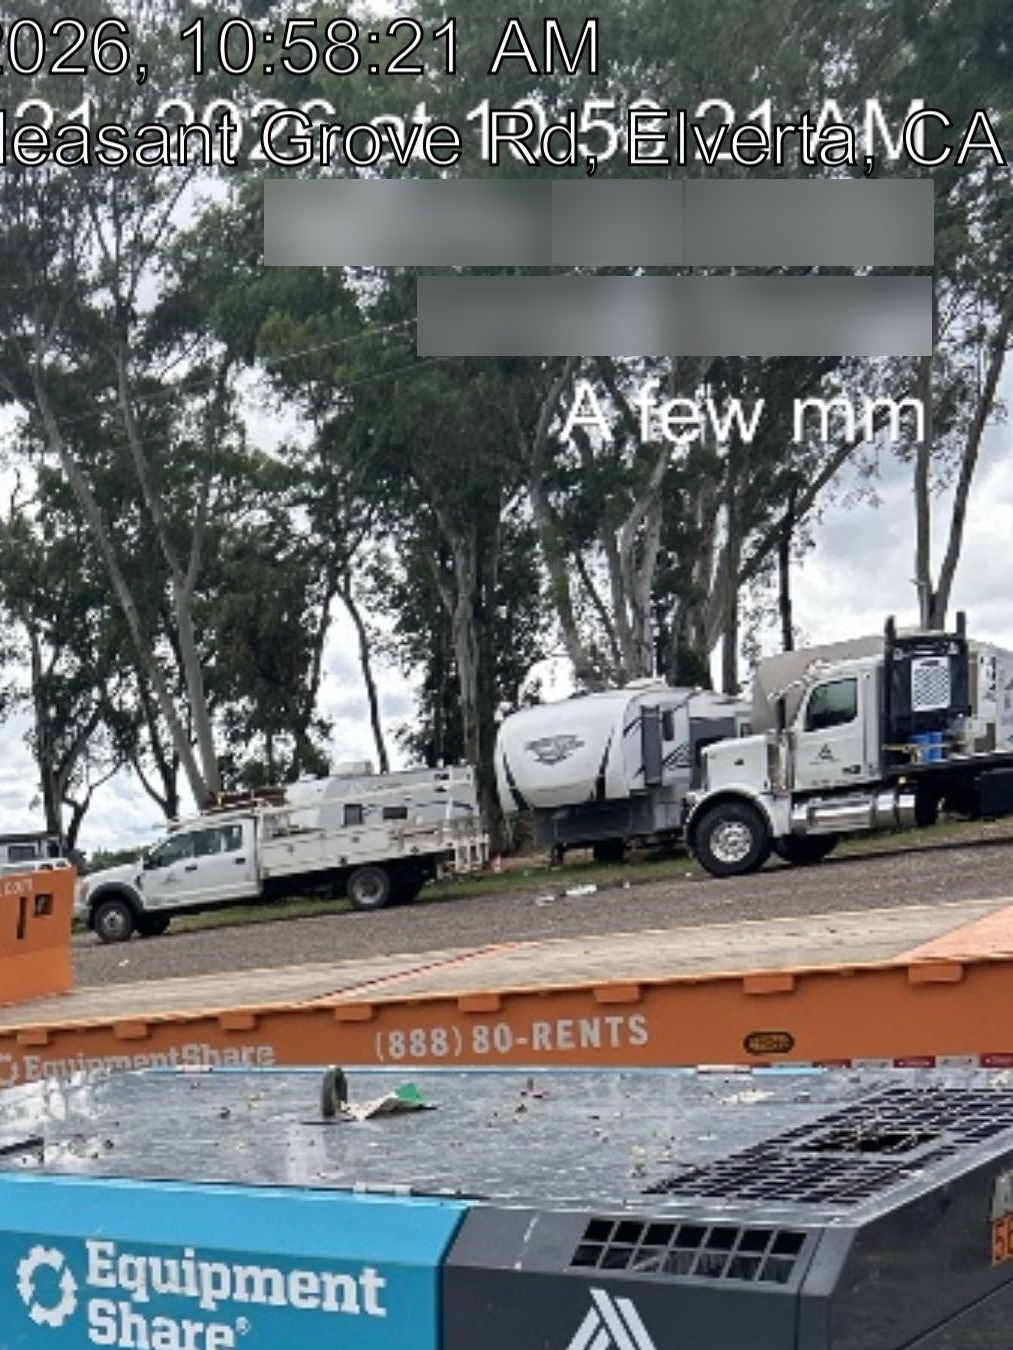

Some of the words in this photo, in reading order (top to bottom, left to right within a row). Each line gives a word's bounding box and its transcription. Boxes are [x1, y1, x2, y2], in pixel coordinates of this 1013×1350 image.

[375, 1026, 463, 1061] (888)
[471, 1014, 649, 1055] 80-RENTS
[84, 1239, 387, 1318] Equipment
